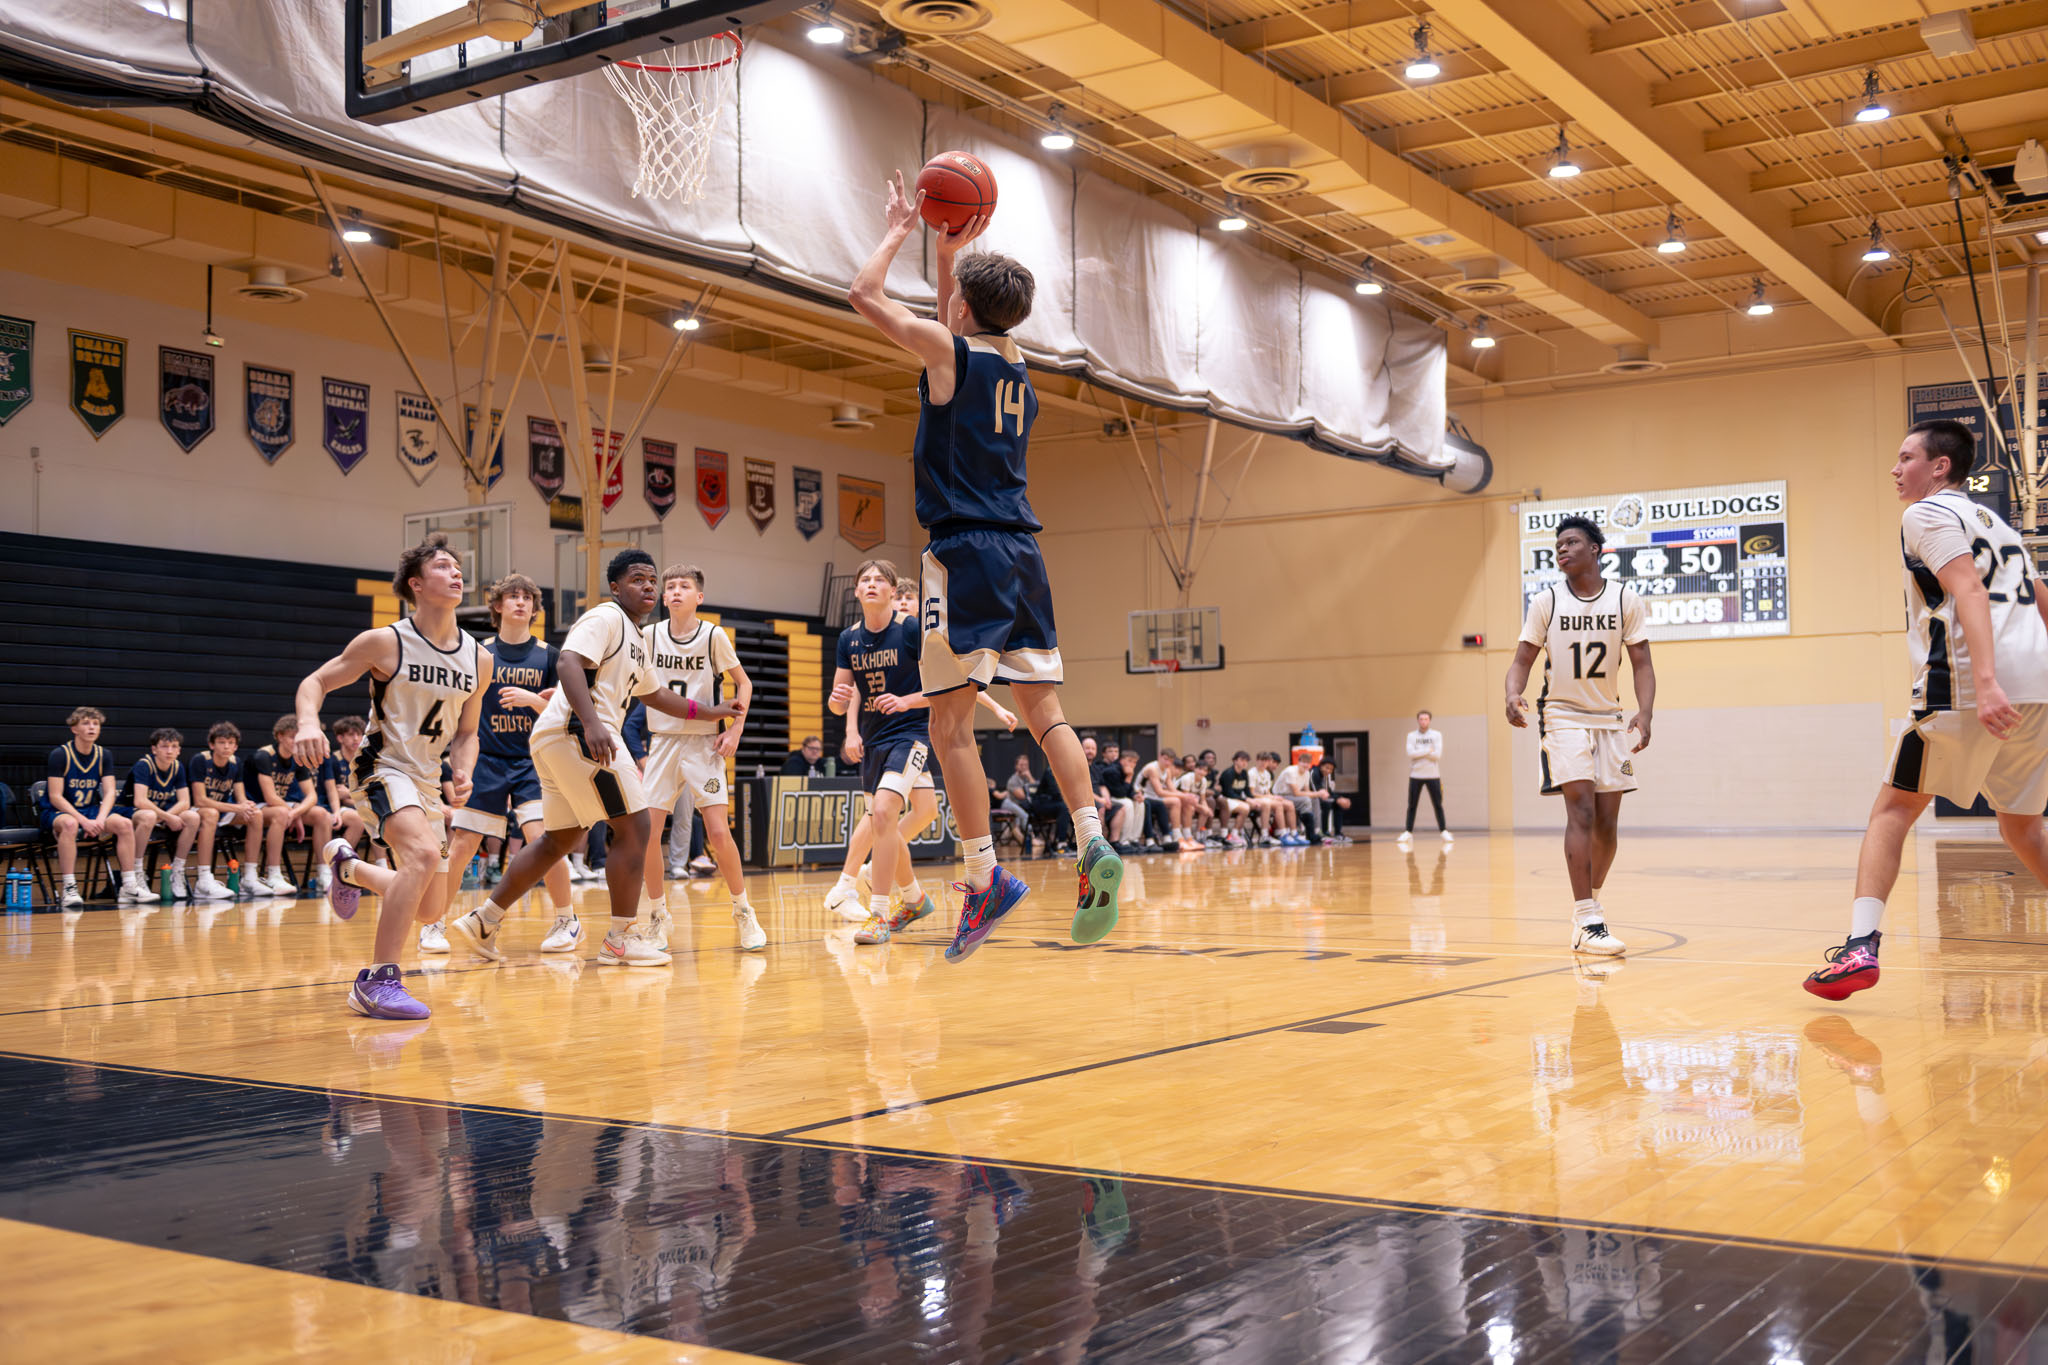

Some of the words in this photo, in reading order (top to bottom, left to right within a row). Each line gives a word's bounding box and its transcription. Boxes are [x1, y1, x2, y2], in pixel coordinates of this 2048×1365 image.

[328, 383, 364, 400] OMAHA
[327, 396, 368, 412] CENTRAL
[400, 407, 437, 422] MARIAN
[994, 378, 1026, 437] 14
[1651, 494, 1781, 520] BULLDOGS
[1693, 527, 1735, 540] STORM
[1600, 552, 1621, 580] 2
[1645, 559, 1656, 571] 4
[1680, 545, 1723, 574] 50
[1559, 614, 1617, 631] BURKE
[656, 653, 705, 671] BURKE
[850, 648, 898, 671] ELKHORN
[1567, 641, 1607, 679] 12
[408, 664, 473, 693] BURKE
[490, 666, 543, 687] KHORN
[864, 671, 886, 694] 23
[418, 699, 445, 743] 4
[491, 714, 533, 733] SOUTH
[780, 791, 850, 850] BURKE
